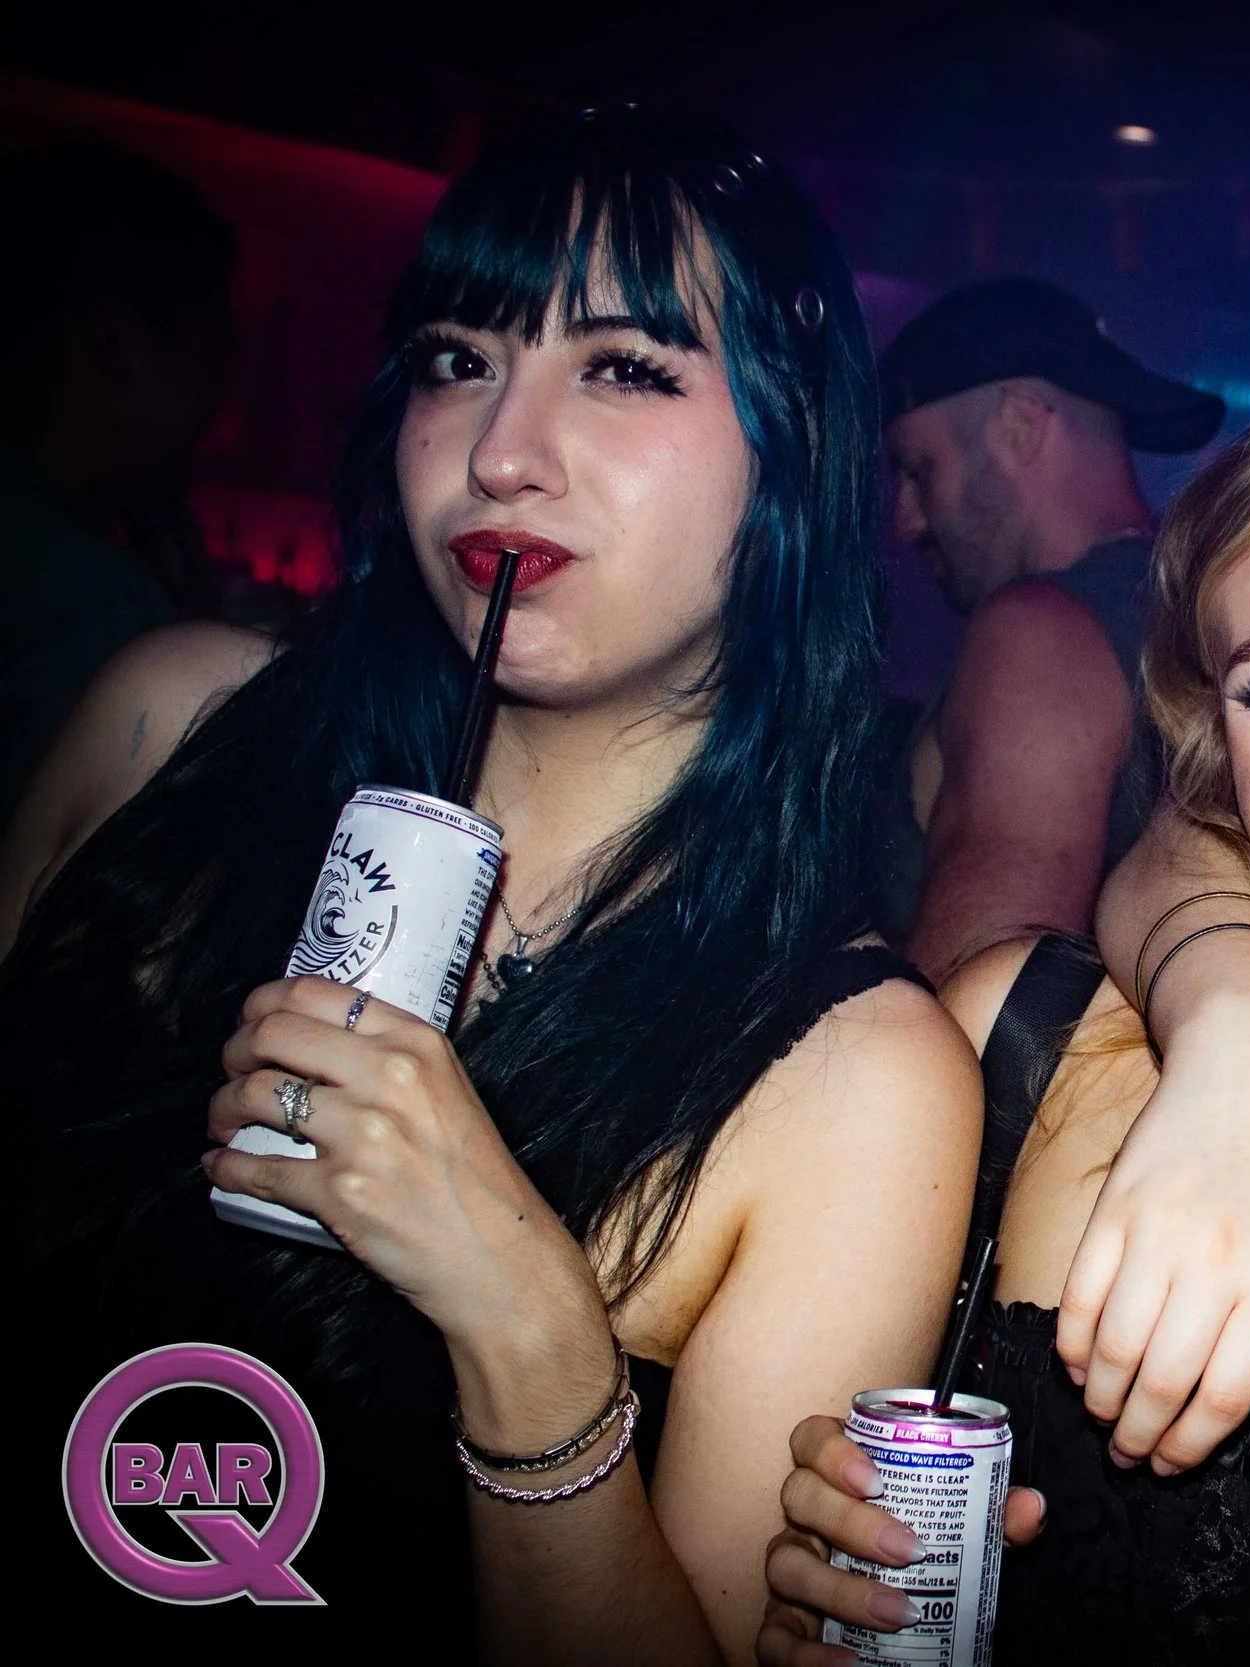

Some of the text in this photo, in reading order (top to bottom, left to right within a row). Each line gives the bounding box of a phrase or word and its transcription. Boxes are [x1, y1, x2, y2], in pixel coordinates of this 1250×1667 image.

[385, 796, 408, 807] CARBS
[415, 804, 443, 818] GLUTEN
[445, 813, 462, 825] FREE
[331, 832, 396, 893] CLAW
[327, 921, 385, 982] LTZER
[858, 1420, 884, 1434] CALORIES
[896, 1428, 918, 1440] BLACK
[920, 1432, 949, 1443] CHERRY
[889, 1452, 910, 1463] COLD
[911, 1454, 934, 1466] WAVE
[925, 1475, 933, 1483] IS
[890, 1484, 909, 1493] COLD
[910, 1486, 929, 1495] WAVE
[931, 1488, 968, 1497] FILTRATION
[891, 1495, 923, 1506] FLAVORS
[926, 1499, 945, 1507] THAT
[905, 1509, 935, 1518] PICKED
[939, 1511, 966, 1519] FRUIT-
[918, 1521, 946, 1530] TASTES
[948, 1522, 965, 1530] AND
[917, 1533, 964, 1542] NO OTHER.
[925, 1550, 959, 1564] acts
[888, 1575, 900, 1584] can
[921, 1602, 954, 1620] 100
